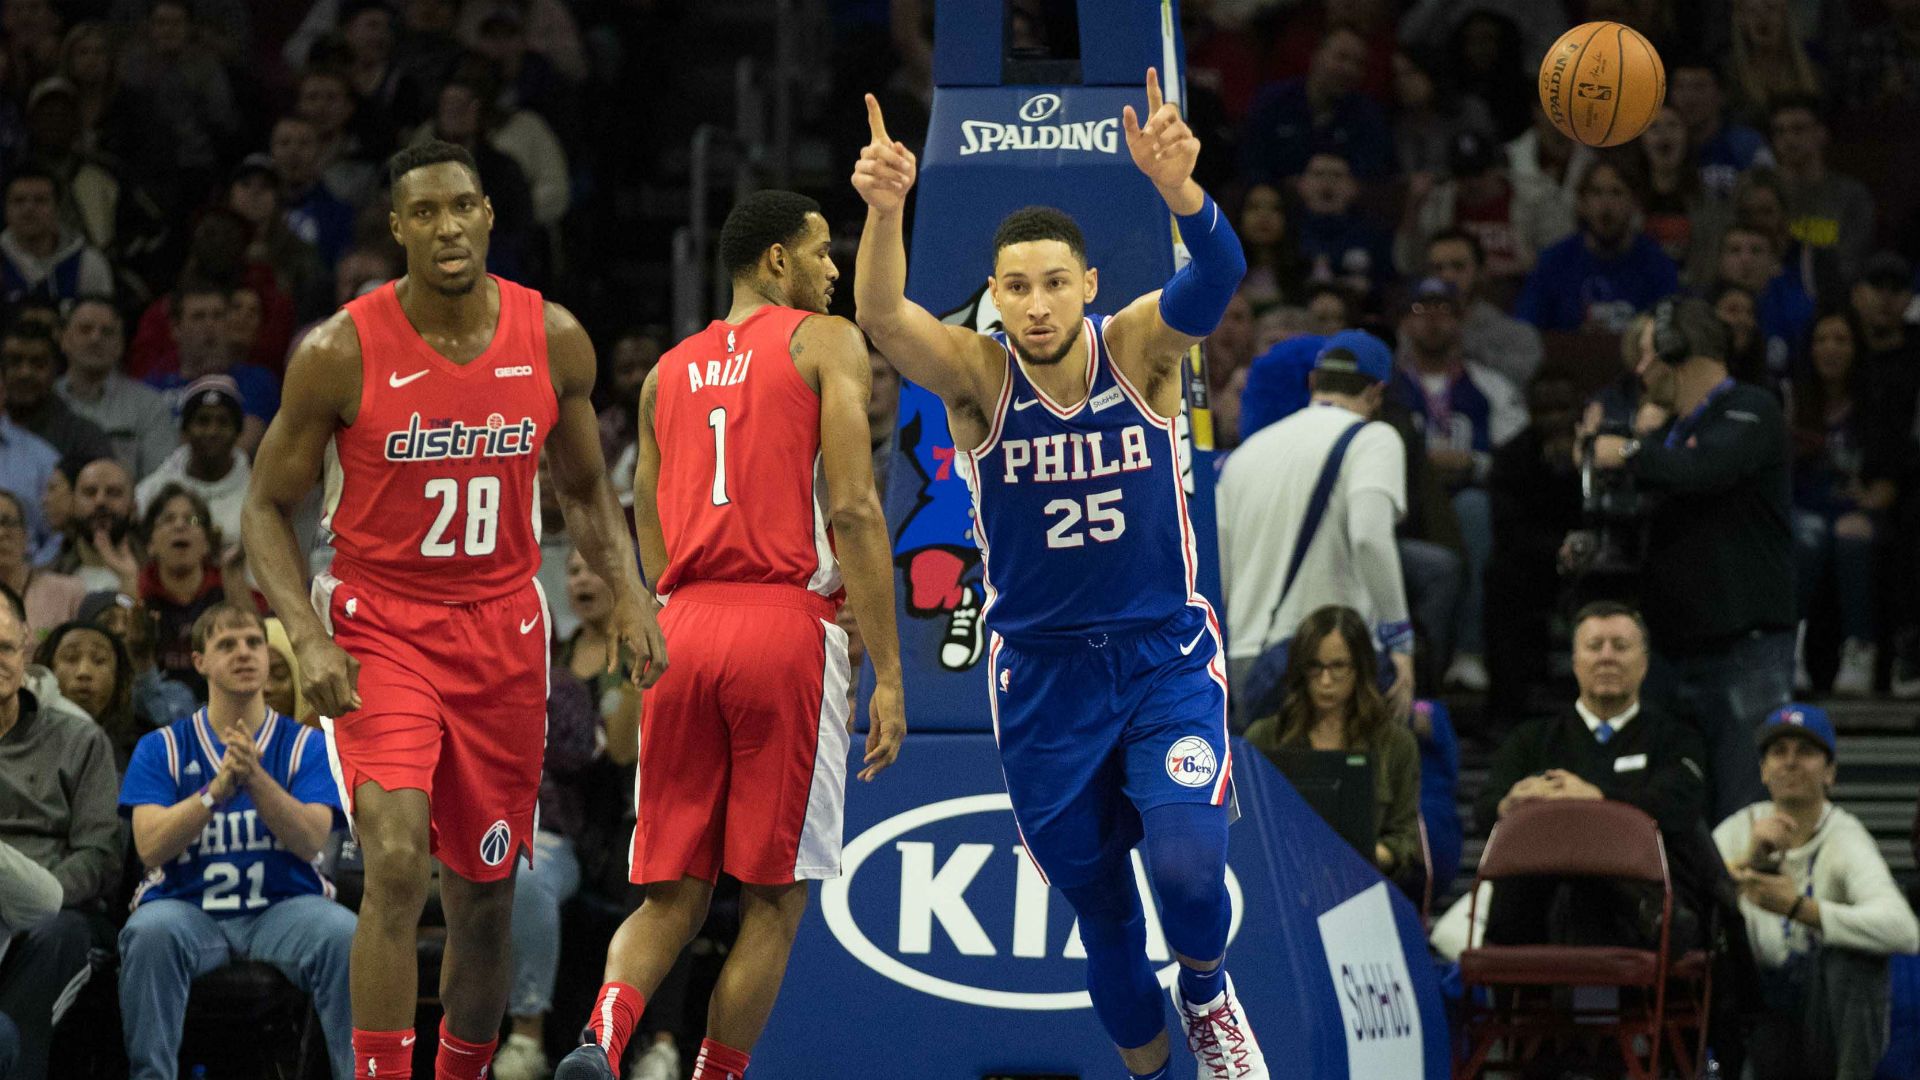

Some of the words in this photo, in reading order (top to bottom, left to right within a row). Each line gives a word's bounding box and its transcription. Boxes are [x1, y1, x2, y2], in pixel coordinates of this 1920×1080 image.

[960, 117, 1119, 156] SPALDING
[494, 365, 533, 378] GEICO
[384, 411, 536, 461] district
[708, 406, 731, 506] 1
[1002, 424, 1152, 484] PHILA
[420, 476, 500, 557] 28
[1043, 488, 1126, 548] 25
[1172, 755, 1212, 774] 76ers
[202, 861, 269, 911] 21
